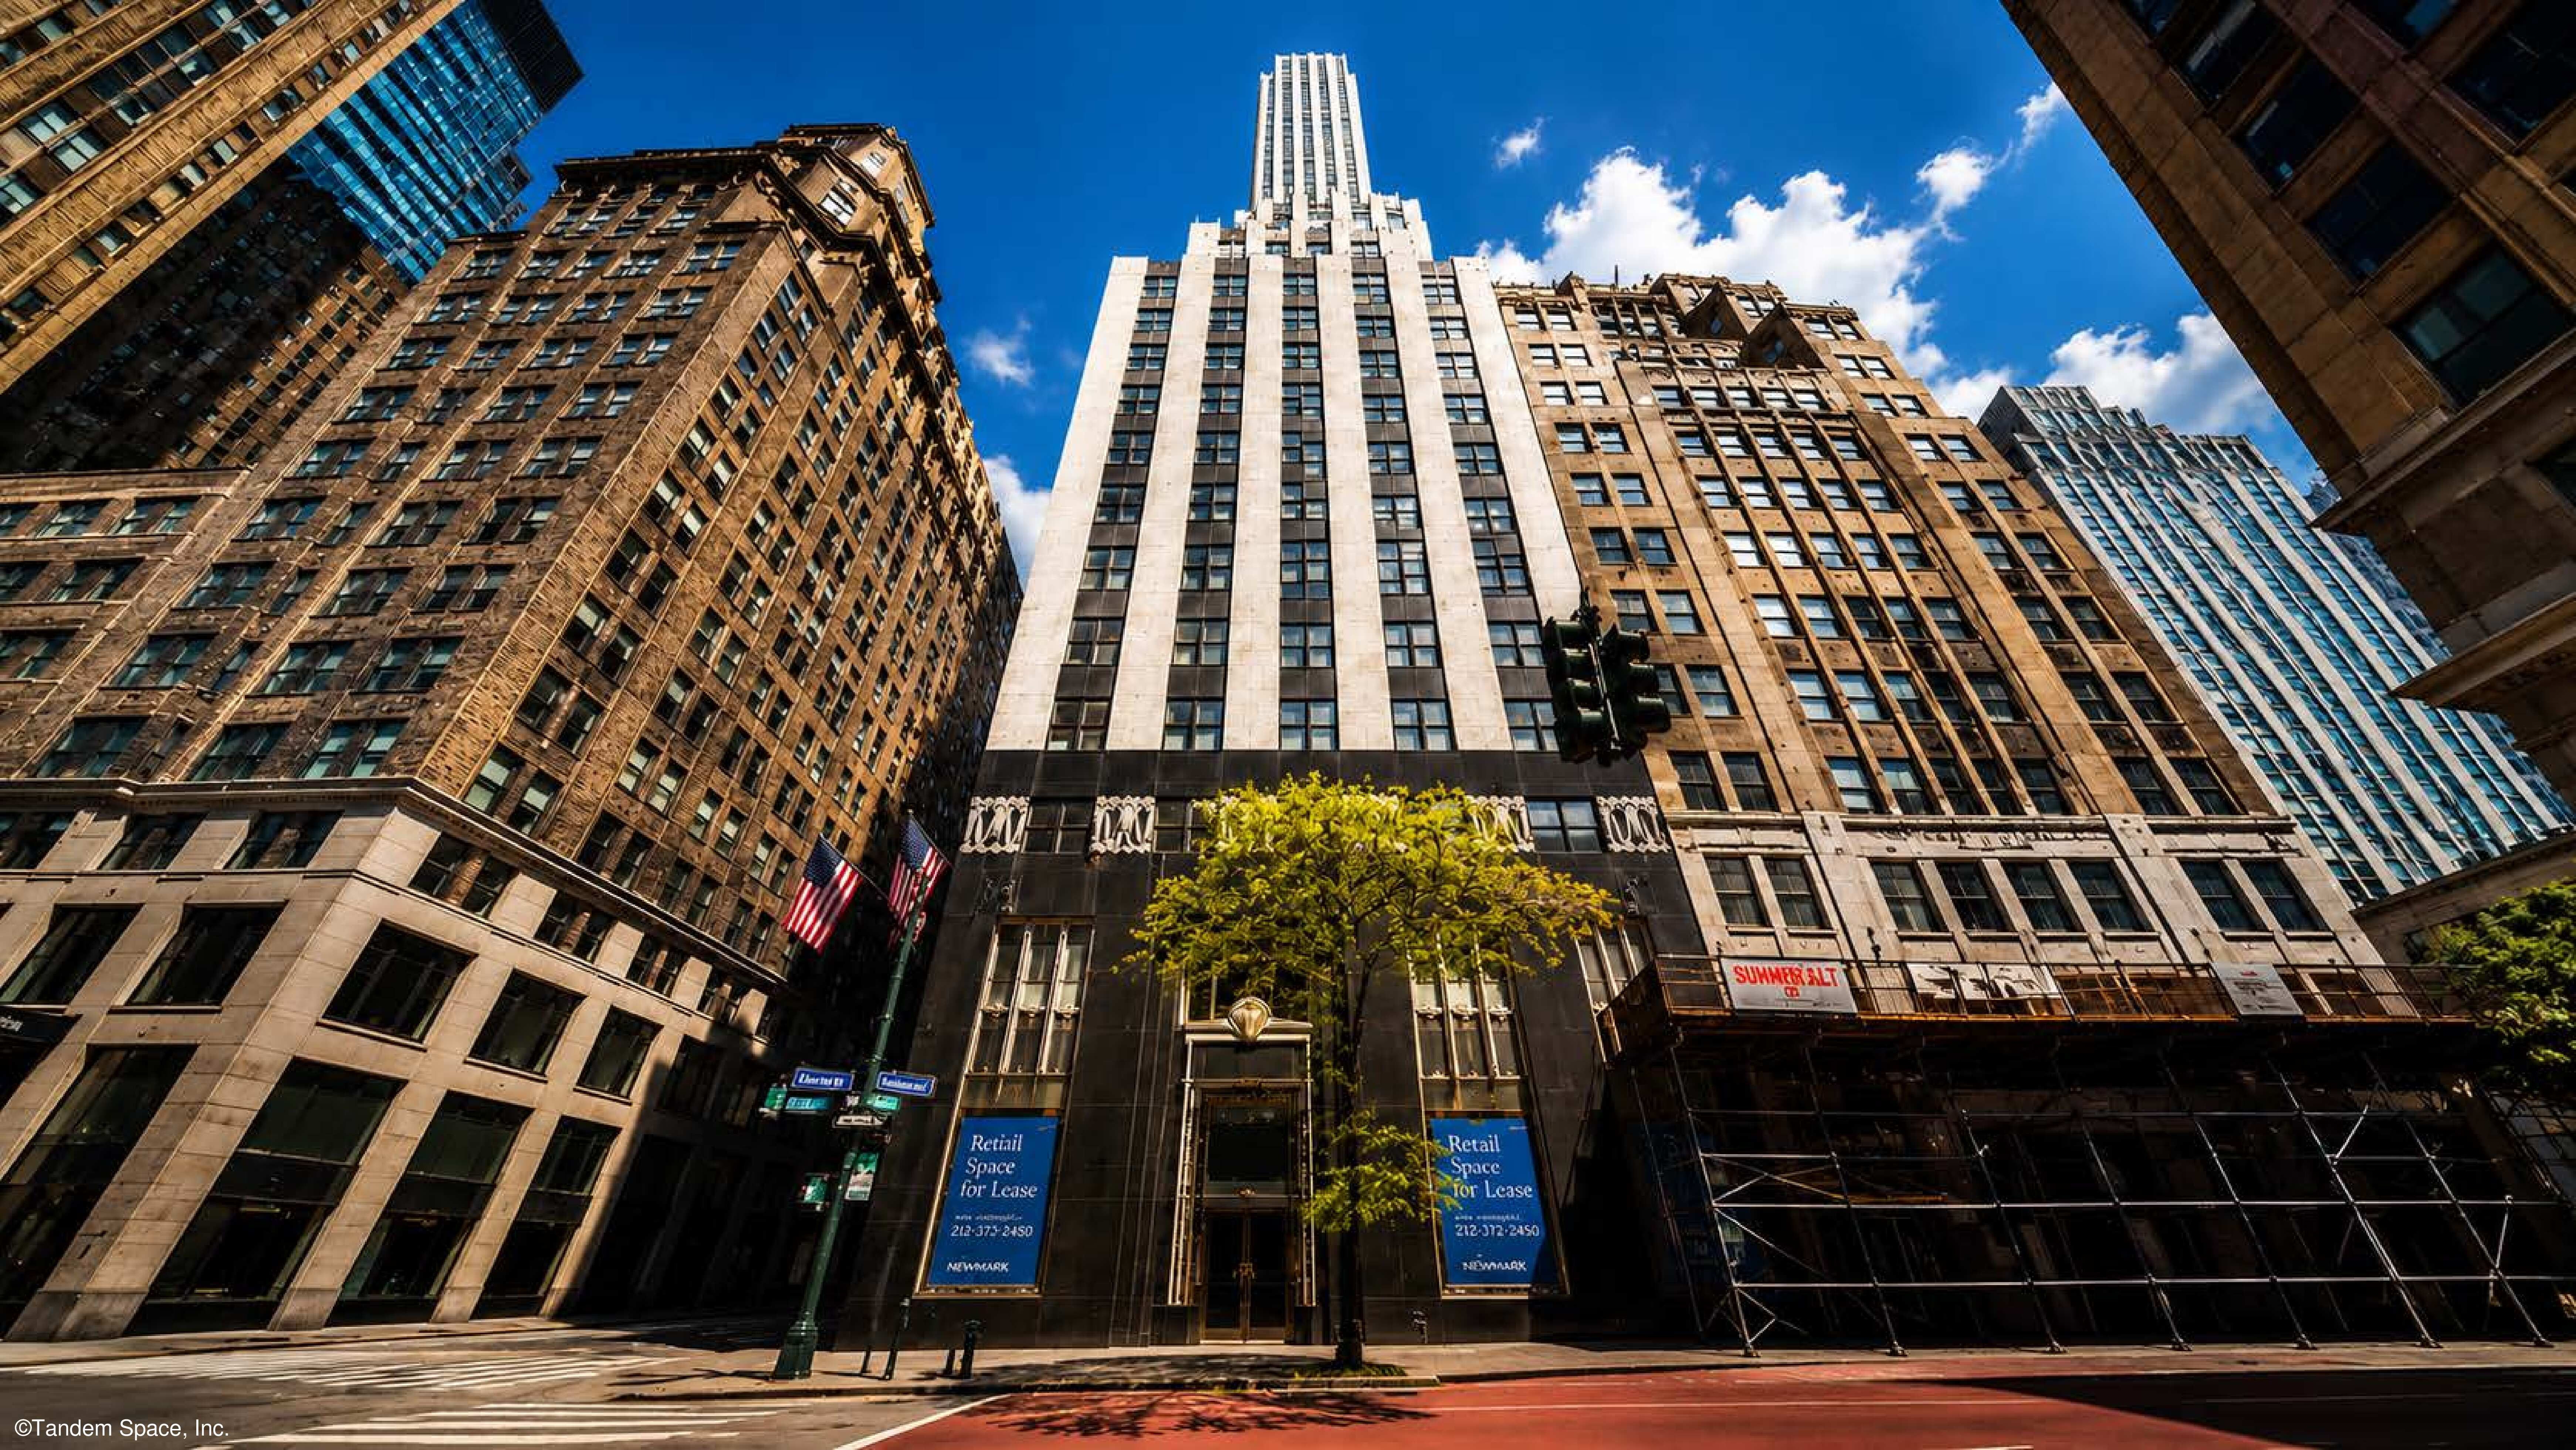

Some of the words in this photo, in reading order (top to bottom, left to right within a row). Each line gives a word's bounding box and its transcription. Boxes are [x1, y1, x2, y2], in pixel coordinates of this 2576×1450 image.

[971, 1134, 1023, 1152] Retail
[1448, 1135, 1500, 1152] Retail
[965, 1158, 1016, 1179] Space
[1451, 1157, 1501, 1179] Space
[961, 1180, 987, 1197] for
[992, 1181, 1038, 1198] Lease
[1453, 1179, 1477, 1198] for
[1485, 1180, 1533, 1198] Lease
[947, 1261, 1010, 1272] NEWMARK
[1463, 1261, 1527, 1272] NEWMARK
